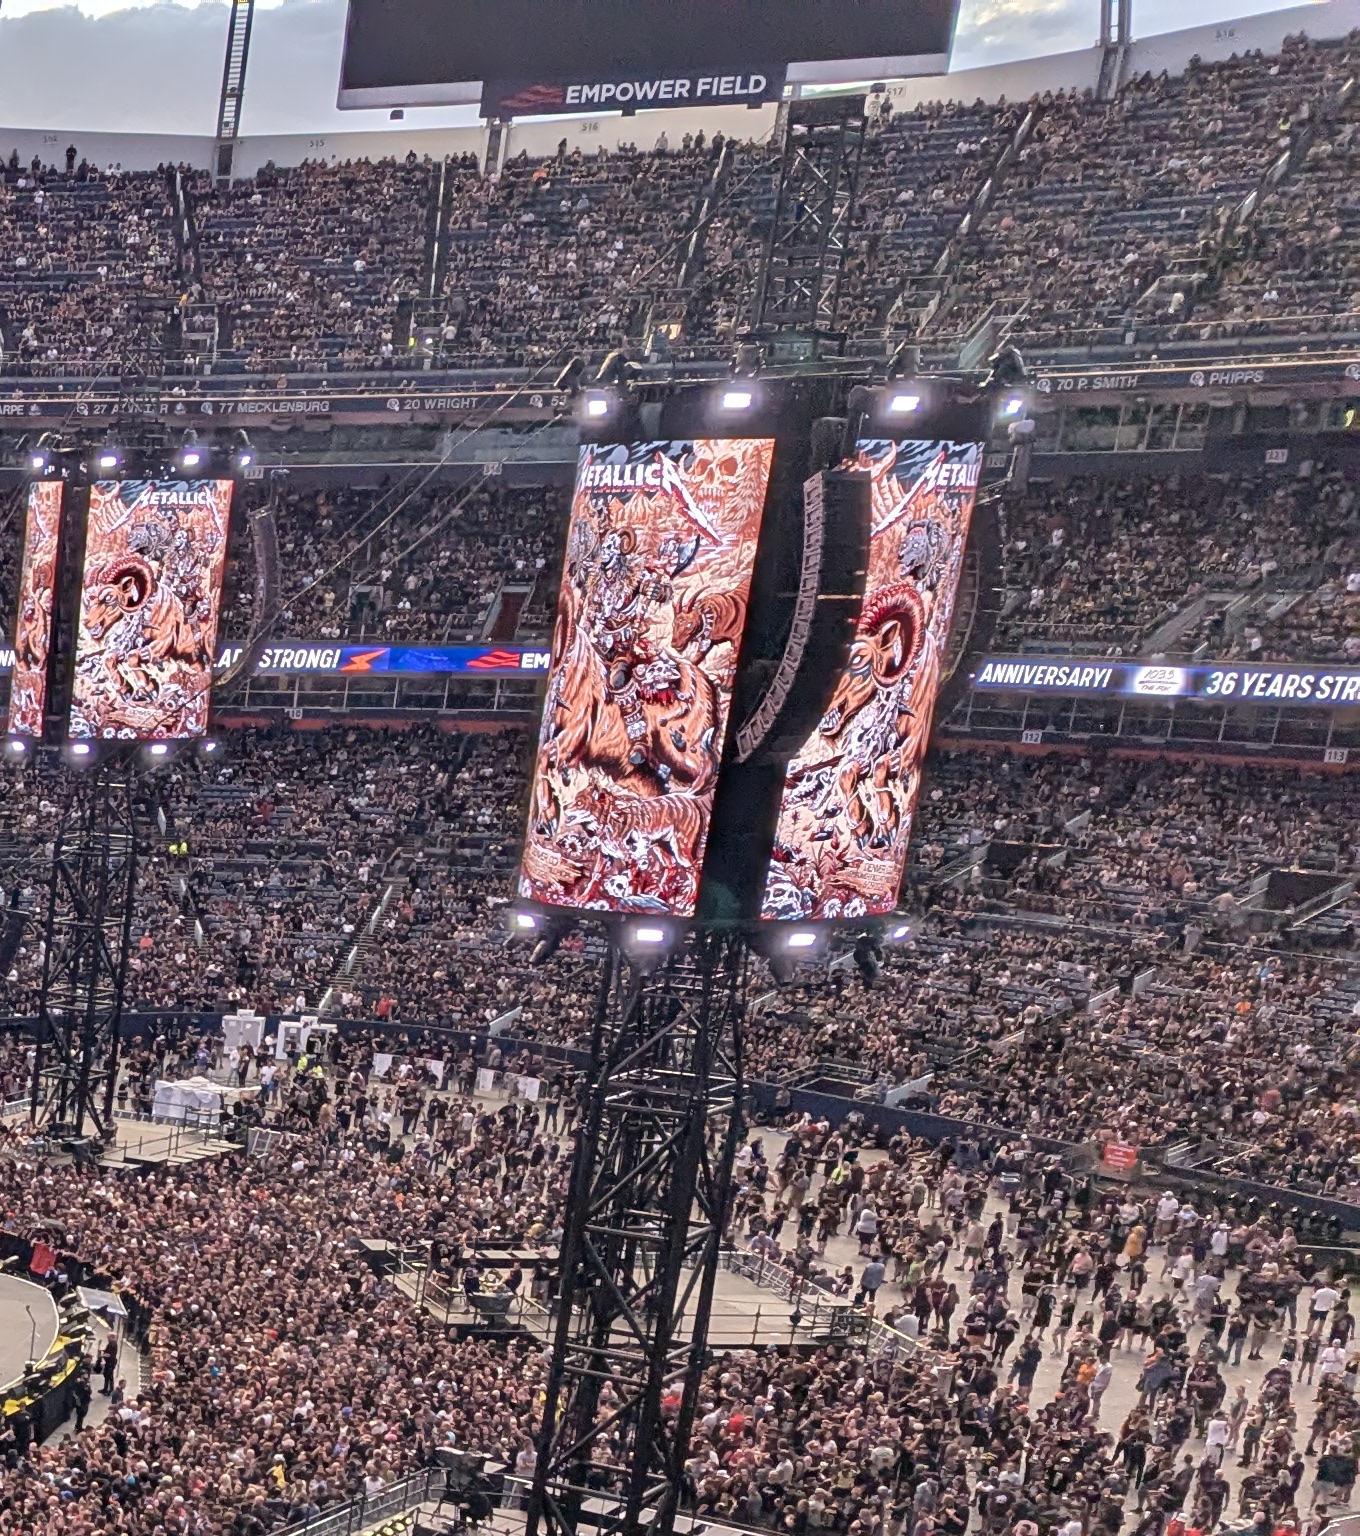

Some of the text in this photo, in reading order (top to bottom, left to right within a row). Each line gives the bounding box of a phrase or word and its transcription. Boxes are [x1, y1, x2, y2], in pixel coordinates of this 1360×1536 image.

[565, 74, 766, 104] EMPOWER FIELD
[581, 121, 598, 133] 516
[1057, 379, 1073, 391] 70
[1092, 375, 1138, 390] SMITH
[1209, 371, 1265, 384] PHIPPS
[93, 403, 107, 414] 27
[219, 401, 330, 413] 77 MECKLENBURG
[404, 397, 479, 410] 20 WRIGHT
[259, 649, 341, 668] STRONG!
[980, 663, 1112, 688] ANNIVERSARY!
[1207, 672, 1236, 694] 36
[1241, 674, 1312, 698] YEARS
